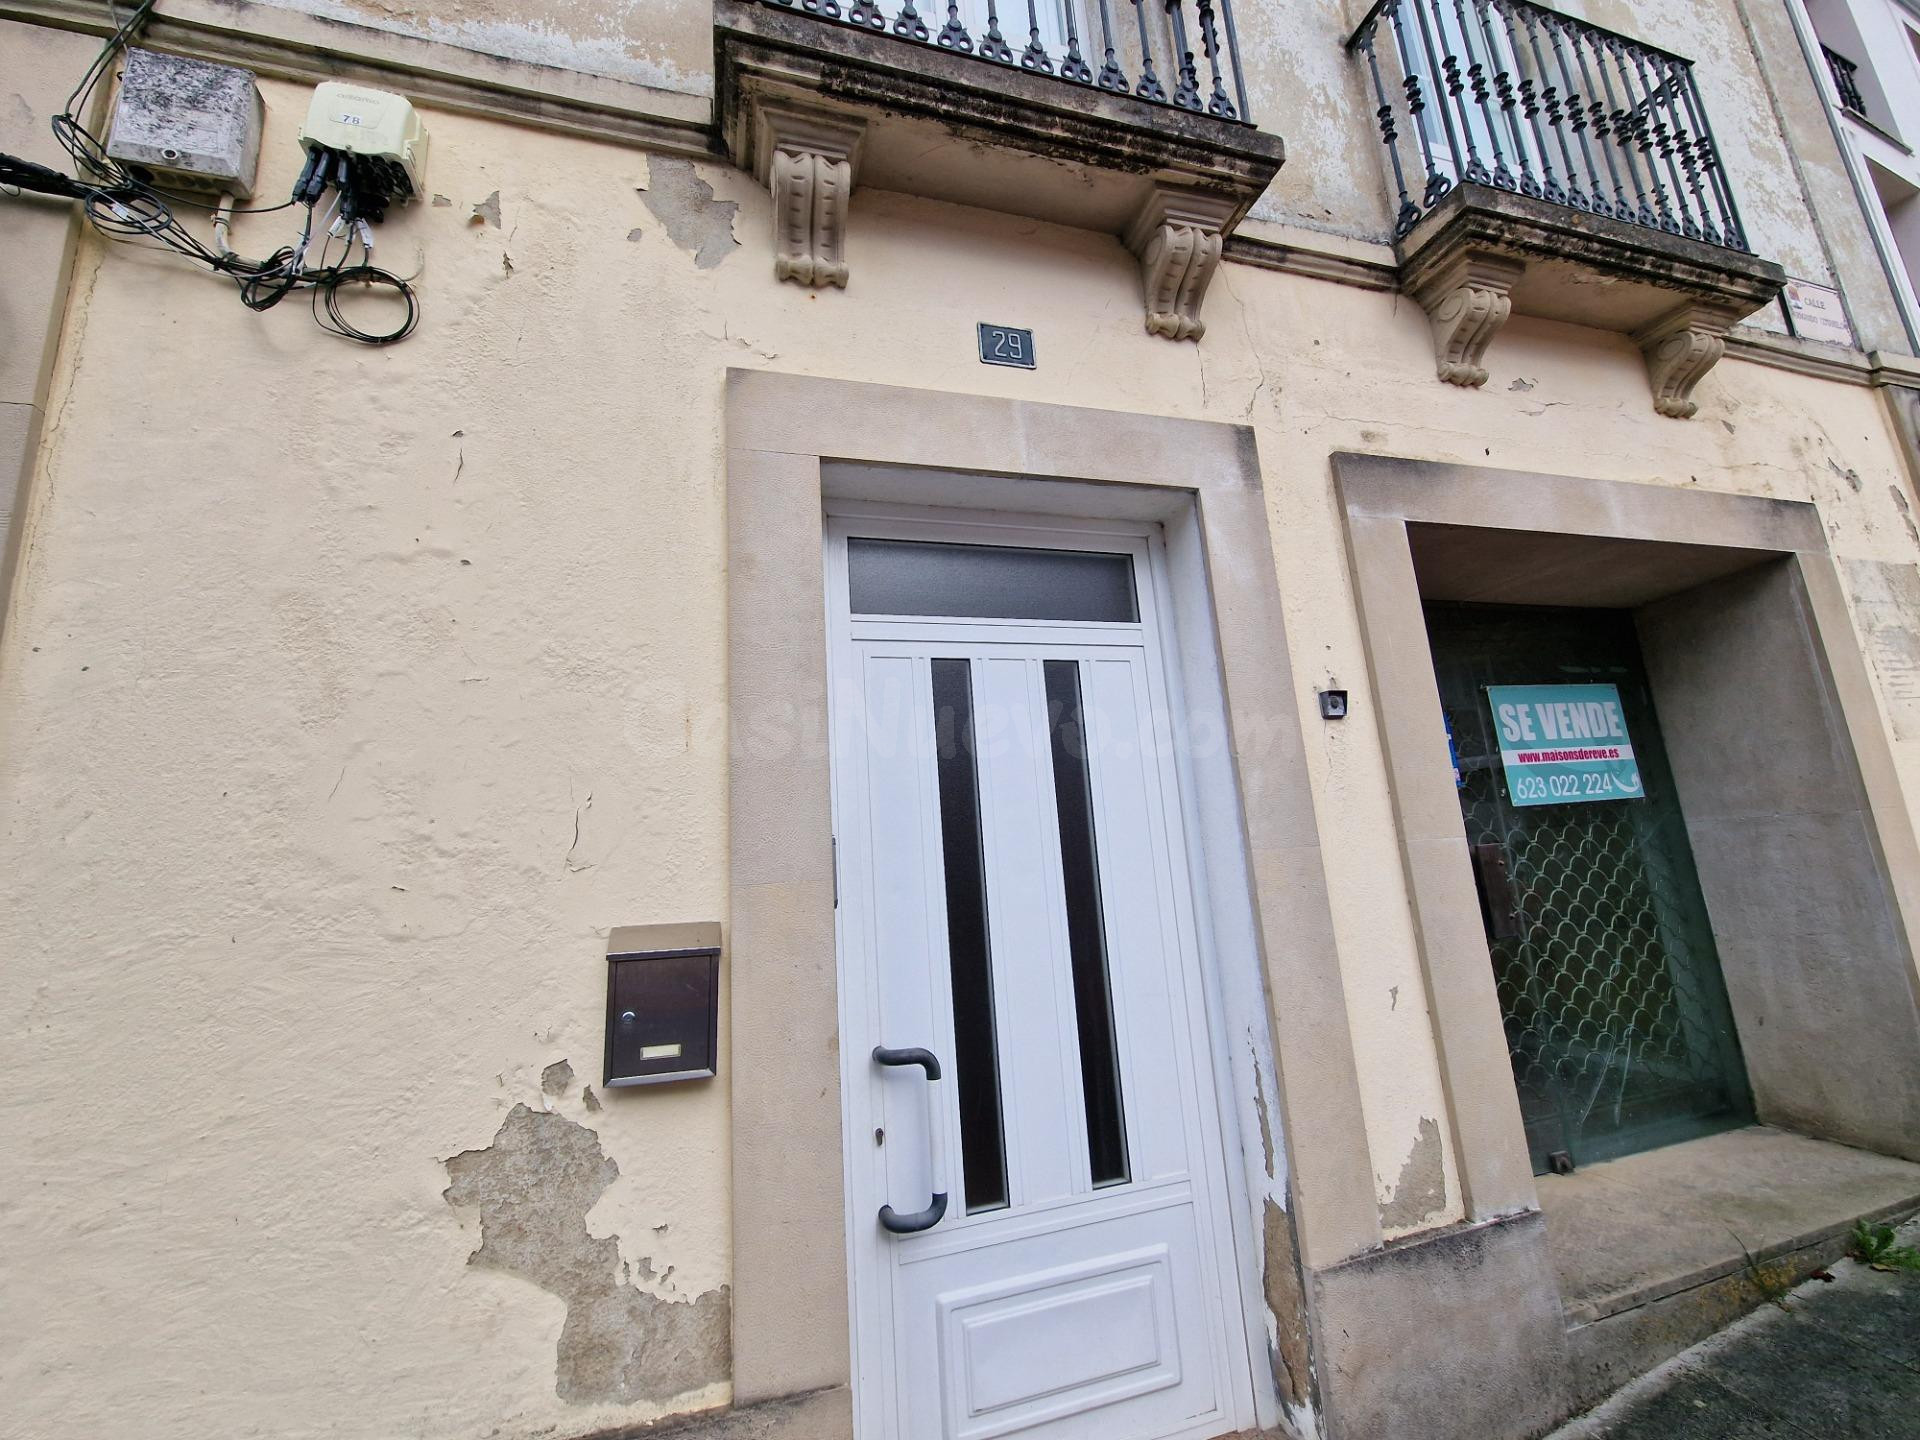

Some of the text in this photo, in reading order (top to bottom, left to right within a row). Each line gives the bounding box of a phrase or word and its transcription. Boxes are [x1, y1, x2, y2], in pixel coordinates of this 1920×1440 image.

[343, 114, 361, 125] 78
[992, 331, 1022, 359] 29
[1498, 702, 1623, 742] SE VENDE
[1518, 748, 1619, 763] www.maisonsdereve.es
[1517, 773, 1612, 799] 623 022 224
